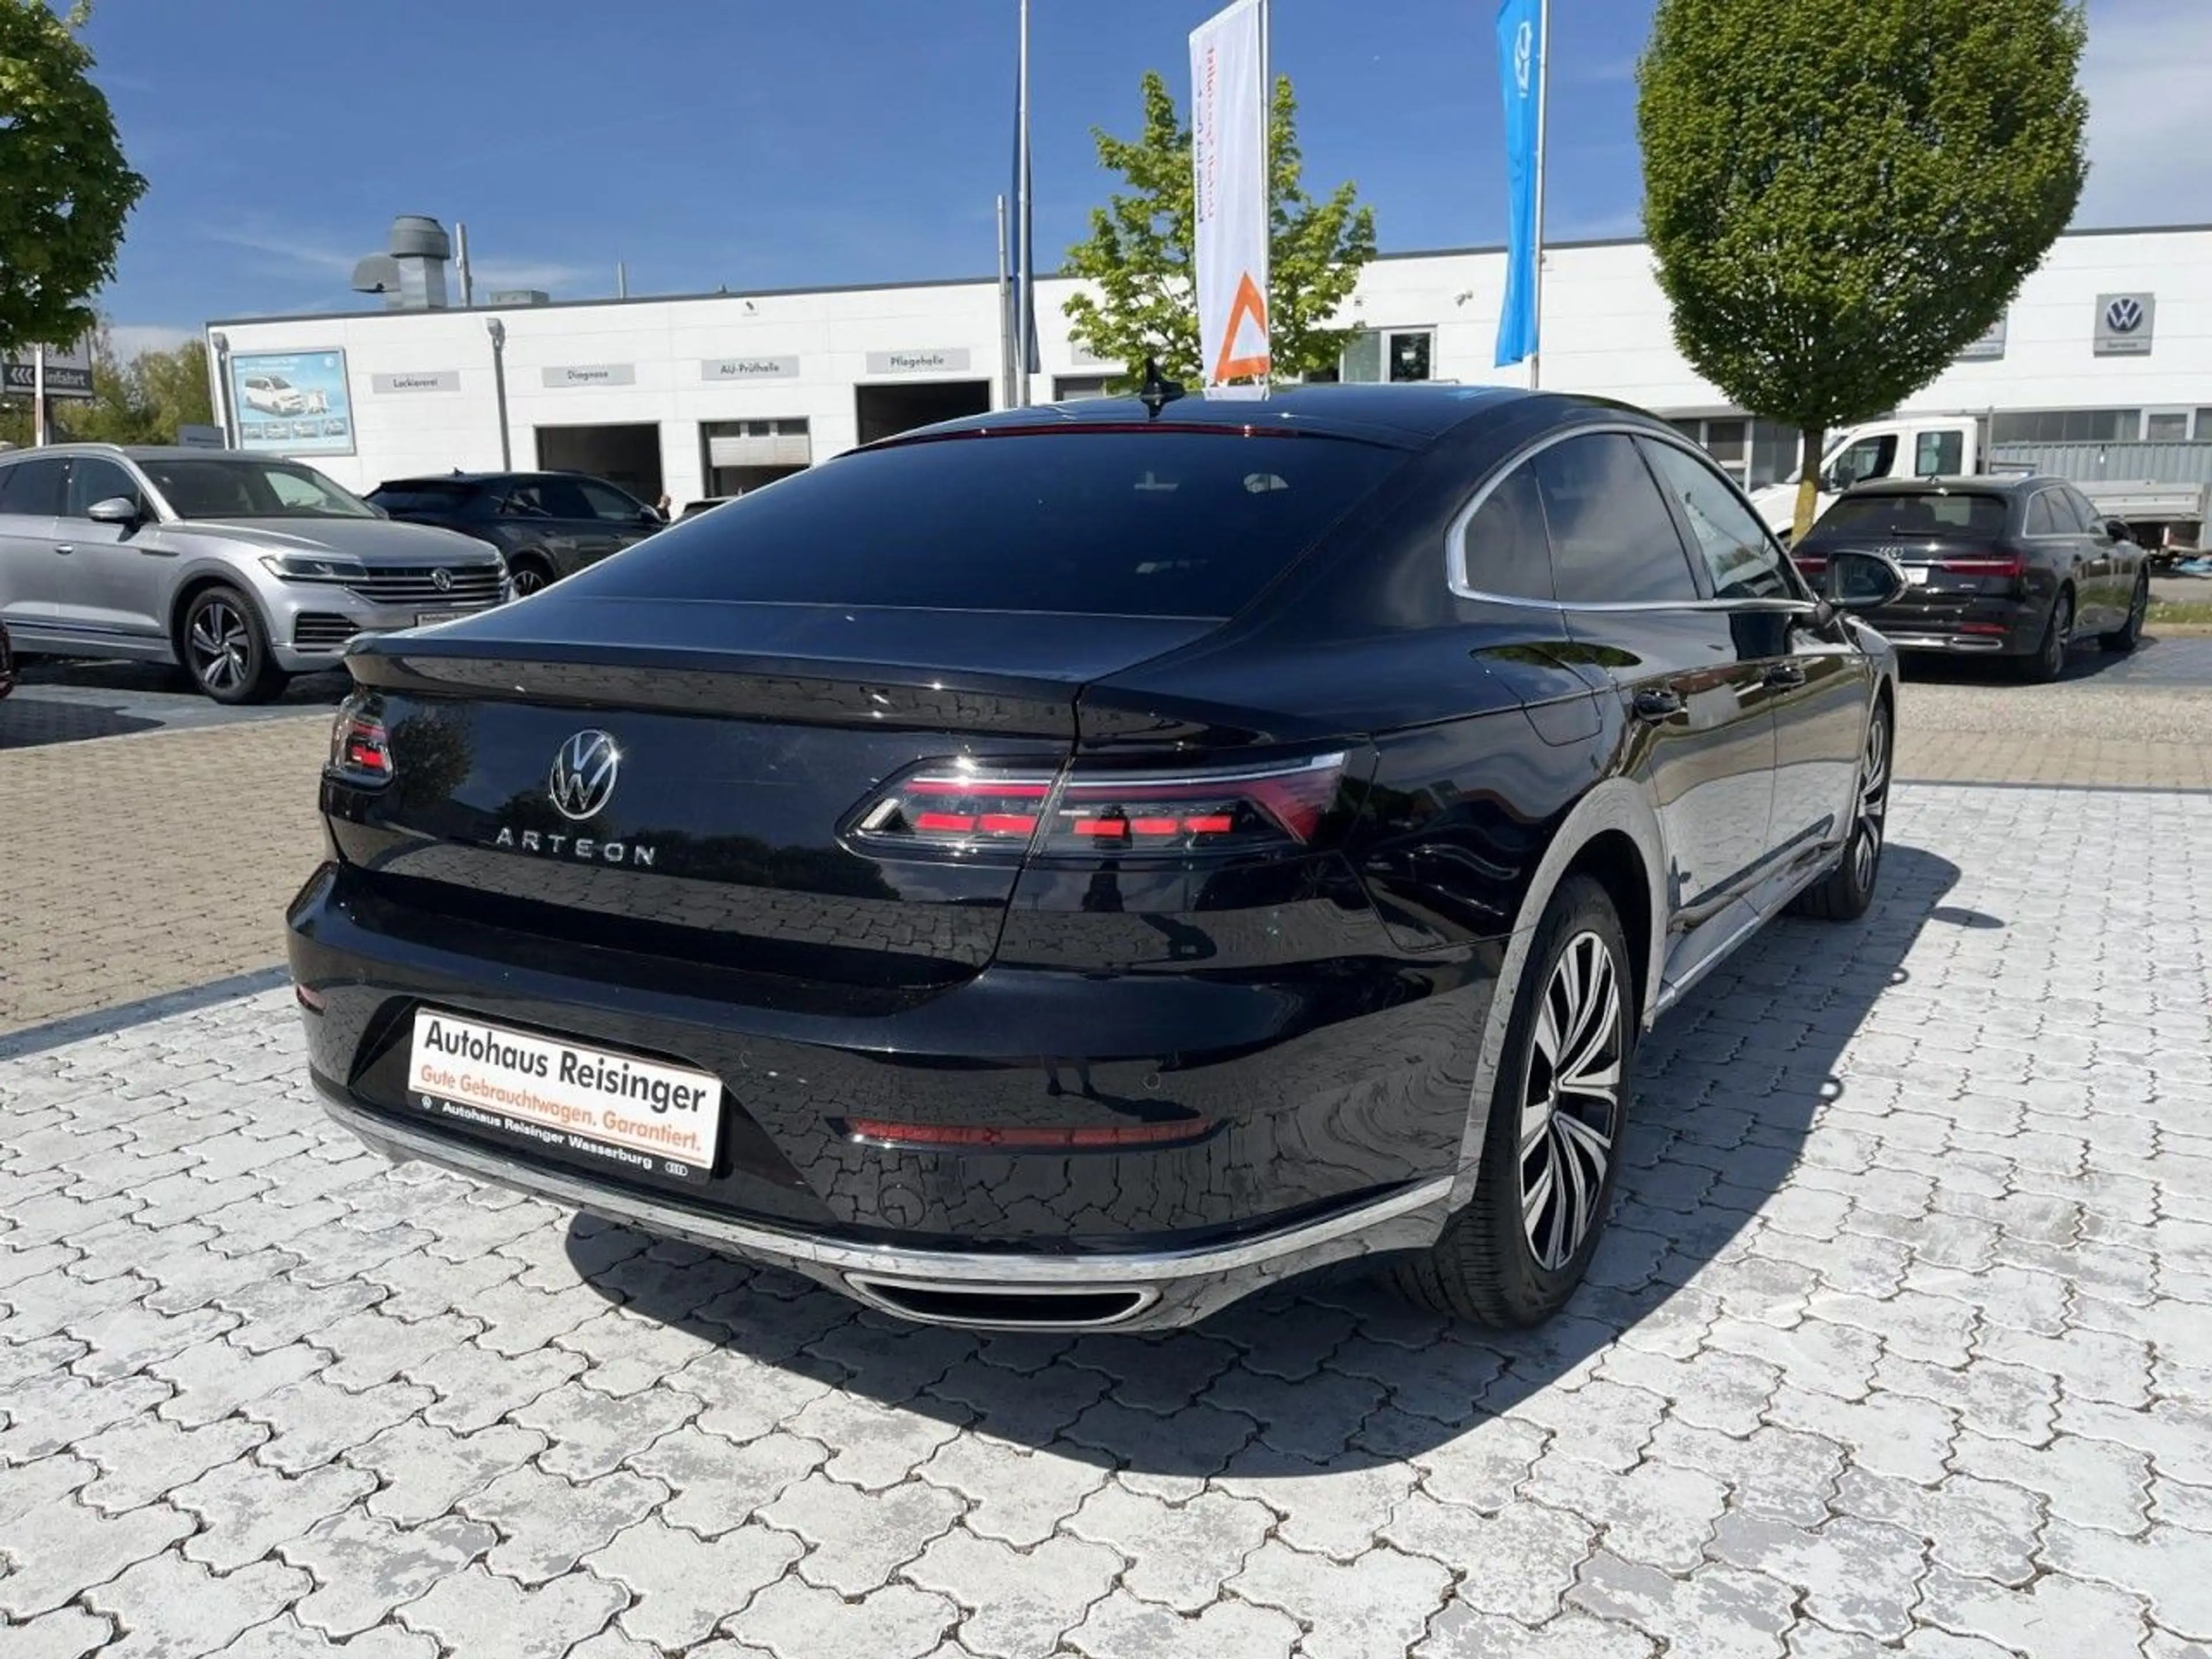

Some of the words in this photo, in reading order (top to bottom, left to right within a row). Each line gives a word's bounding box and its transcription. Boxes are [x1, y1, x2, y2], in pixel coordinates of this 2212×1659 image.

[567, 369, 608, 381] Diagnose
[891, 355, 945, 368] Pflegehalle
[496, 827, 656, 866] ARTEON
[424, 1020, 549, 1078] Autohaus
[559, 1050, 707, 1114] Reisinger
[421, 1064, 456, 1089] Gute
[460, 1073, 597, 1127] Gebrauchtwagen.
[602, 1109, 702, 1152] Garantiert.
[442, 1101, 501, 1127] Autohaus
[505, 1118, 566, 1143] Reisinger
[568, 1135, 653, 1171] Wasserburg
